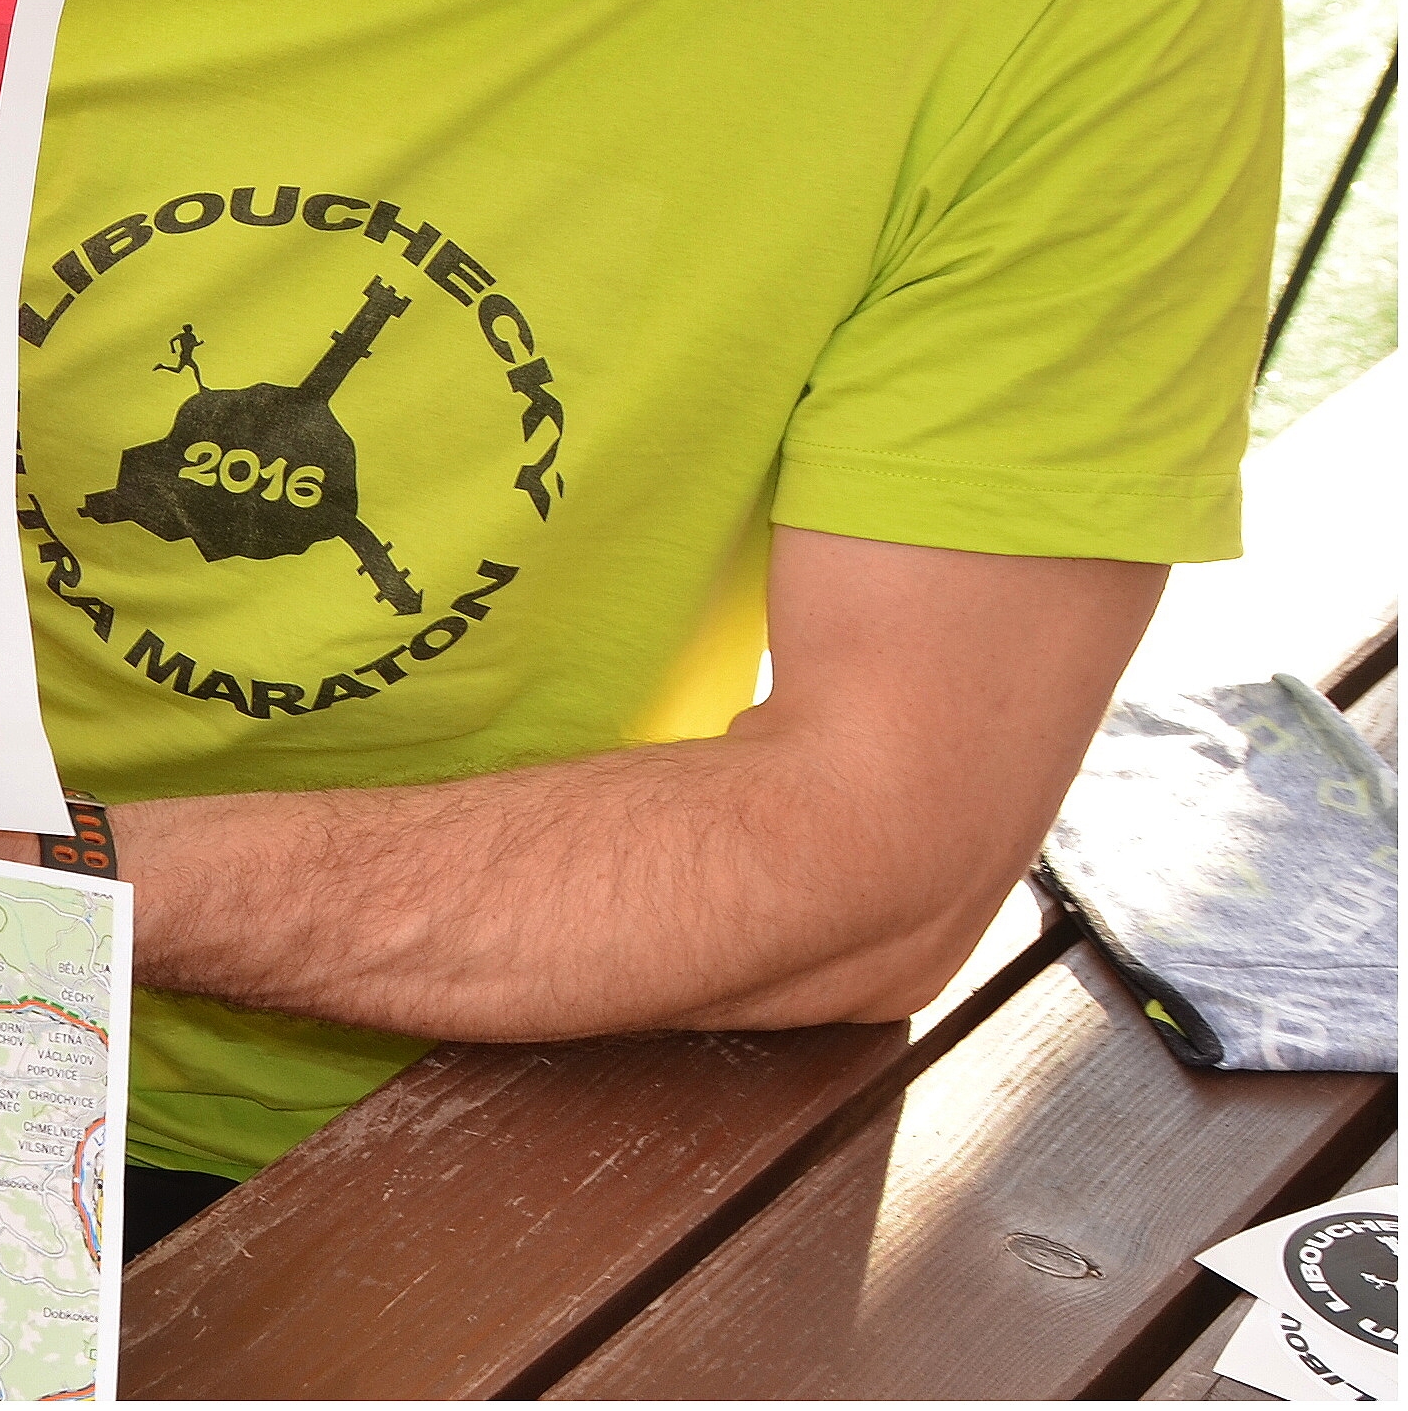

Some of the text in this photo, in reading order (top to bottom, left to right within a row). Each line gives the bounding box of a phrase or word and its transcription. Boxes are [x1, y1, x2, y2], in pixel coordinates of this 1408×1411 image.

[18, 186, 566, 523] LIBOUCHECKÝ
[178, 441, 327, 509] 2016
[123, 559, 520, 720] MARATON
